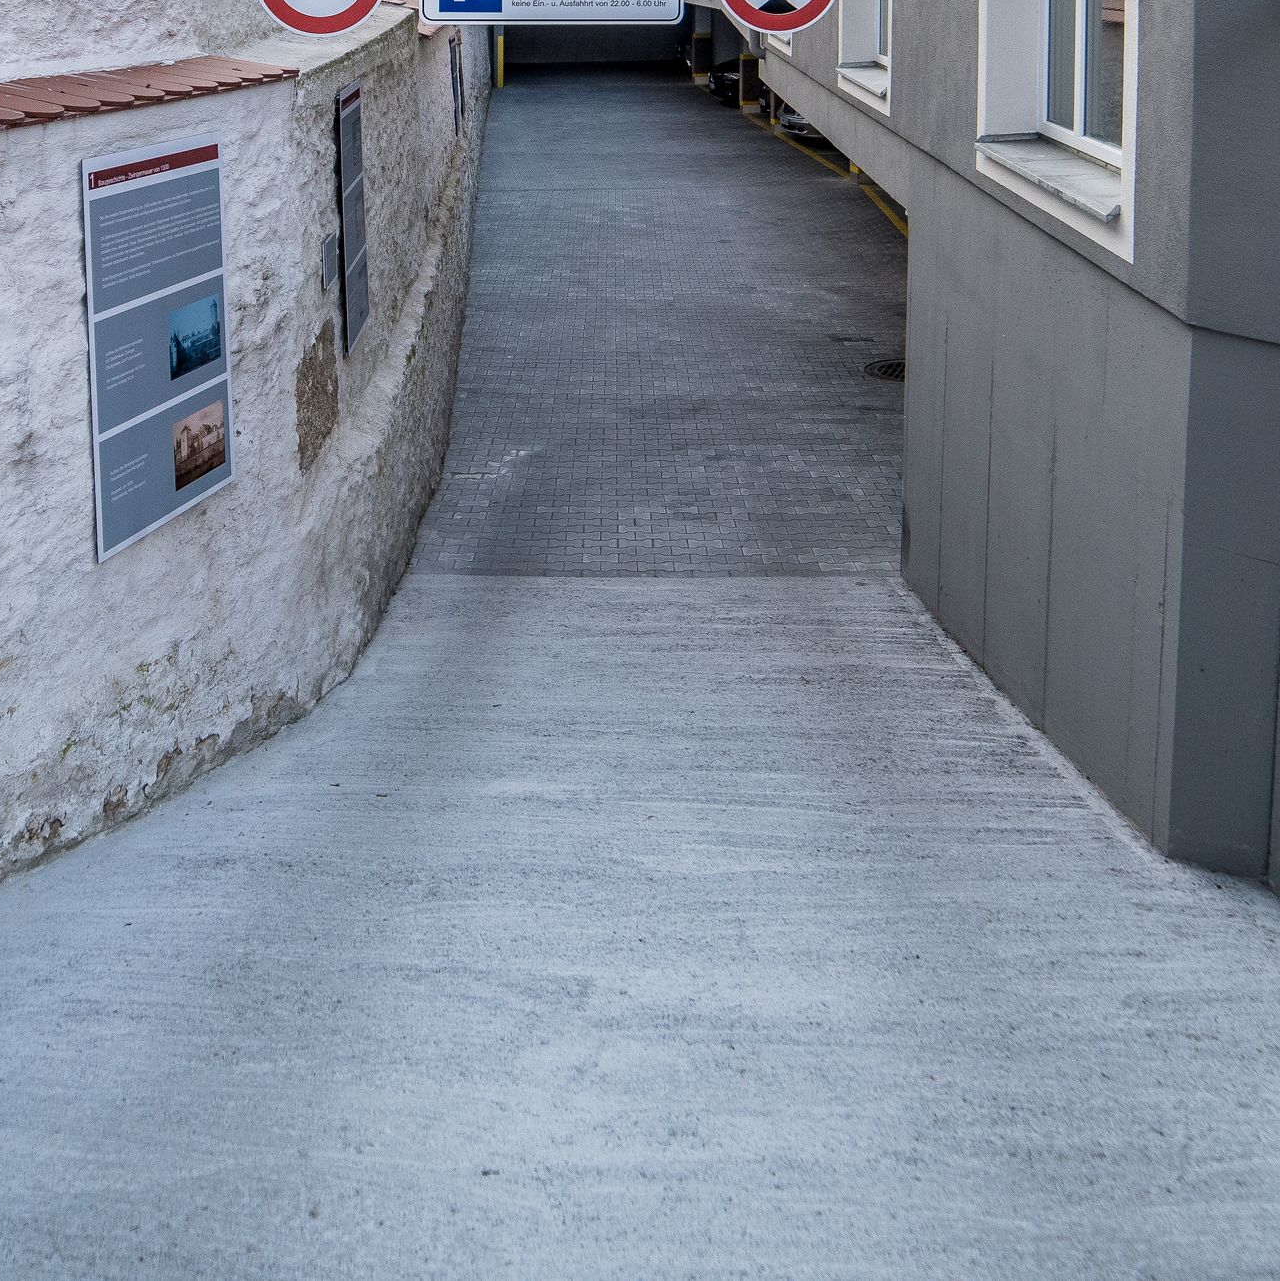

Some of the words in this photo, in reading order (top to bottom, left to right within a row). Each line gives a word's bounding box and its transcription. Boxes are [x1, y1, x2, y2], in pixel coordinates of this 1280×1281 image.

[511, 0, 531, 8] keine
[550, 0, 558, 8] u.
[595, 0, 609, 8] von
[610, 0, 630, 8] 22.00
[636, 0, 652, 8] 6.00
[653, 0, 667, 8] Uhr
[89, 173, 95, 188] 1
